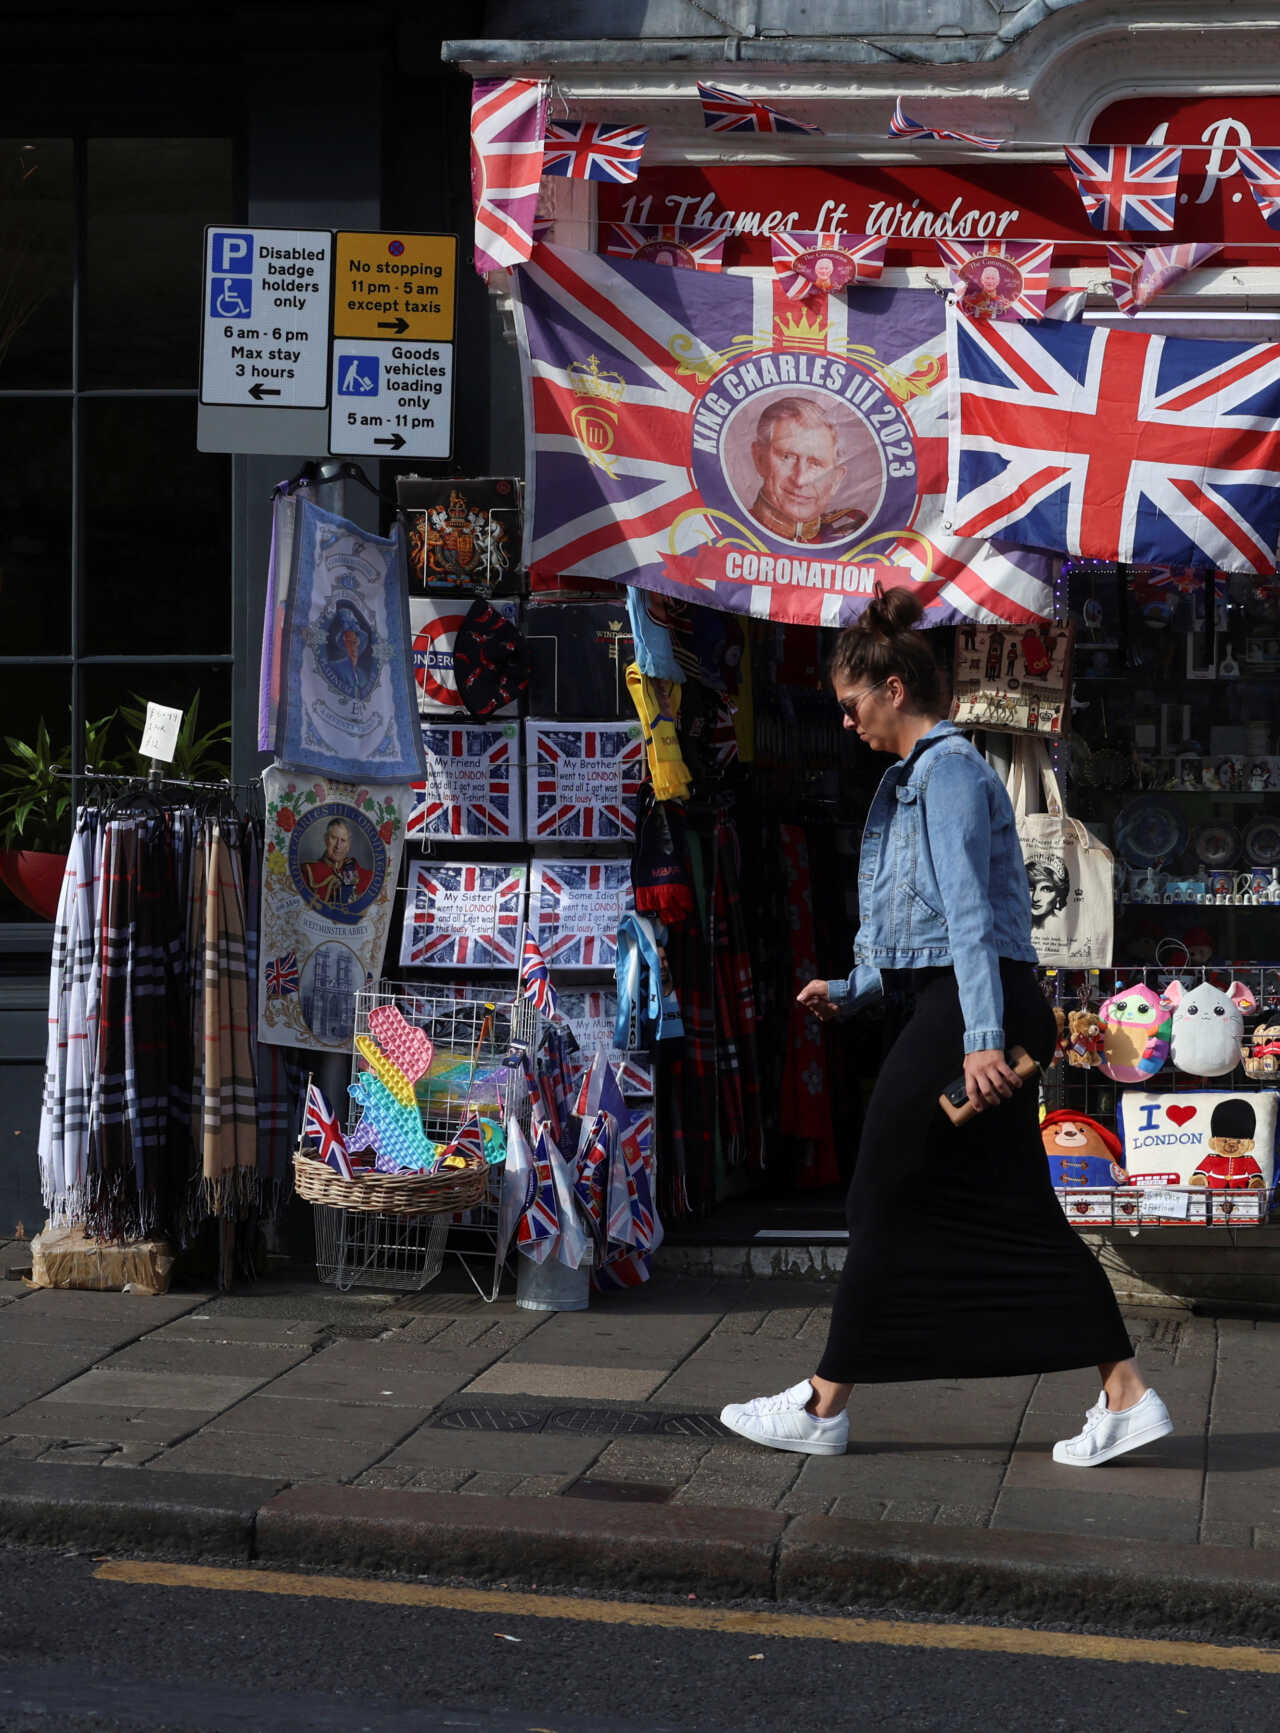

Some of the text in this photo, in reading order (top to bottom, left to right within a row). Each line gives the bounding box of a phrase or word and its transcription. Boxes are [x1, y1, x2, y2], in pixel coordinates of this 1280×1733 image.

[621, 195, 653, 224] 11
[665, 191, 798, 237] Thames
[865, 196, 1020, 238] Windsor
[258, 246, 325, 261] Disabled
[267, 263, 315, 278] badge
[350, 259, 442, 277] No stopping
[262, 278, 320, 293] holders
[352, 280, 363, 292] 11
[368, 283, 391, 295] pm
[403, 282, 413, 294] 5
[416, 285, 438, 295] am
[274, 295, 306, 310] only
[347, 300, 441, 313] except taxis
[224, 326, 234, 338] 6
[237, 329, 260, 339] am
[272, 328, 282, 340] 6
[286, 331, 309, 343] pm
[231, 346, 301, 363] Max stay
[392, 347, 440, 361] Goods
[235, 364, 295, 378] 3 hours
[384, 363, 446, 377] vehicles
[387, 379, 442, 394] loading
[398, 396, 430, 410] only
[347, 413, 356, 425] 5
[360, 416, 383, 426] am
[395, 414, 407, 426] 11
[411, 417, 434, 430] pm
[693, 355, 916, 479] KING CHARLES III 2023
[724, 552, 876, 594] CORONATION
[434, 758, 481, 768] My Friend
[563, 760, 617, 770] My Brother
[454, 771, 487, 779] LONDON
[587, 772, 618, 781] LONDON
[561, 783, 574, 792] and
[591, 784, 603, 795] got
[443, 892, 492, 903] My Sister
[464, 904, 496, 913] LONDON
[1138, 1103, 1162, 1132] I
[1132, 1132, 1203, 1150] LONDON
